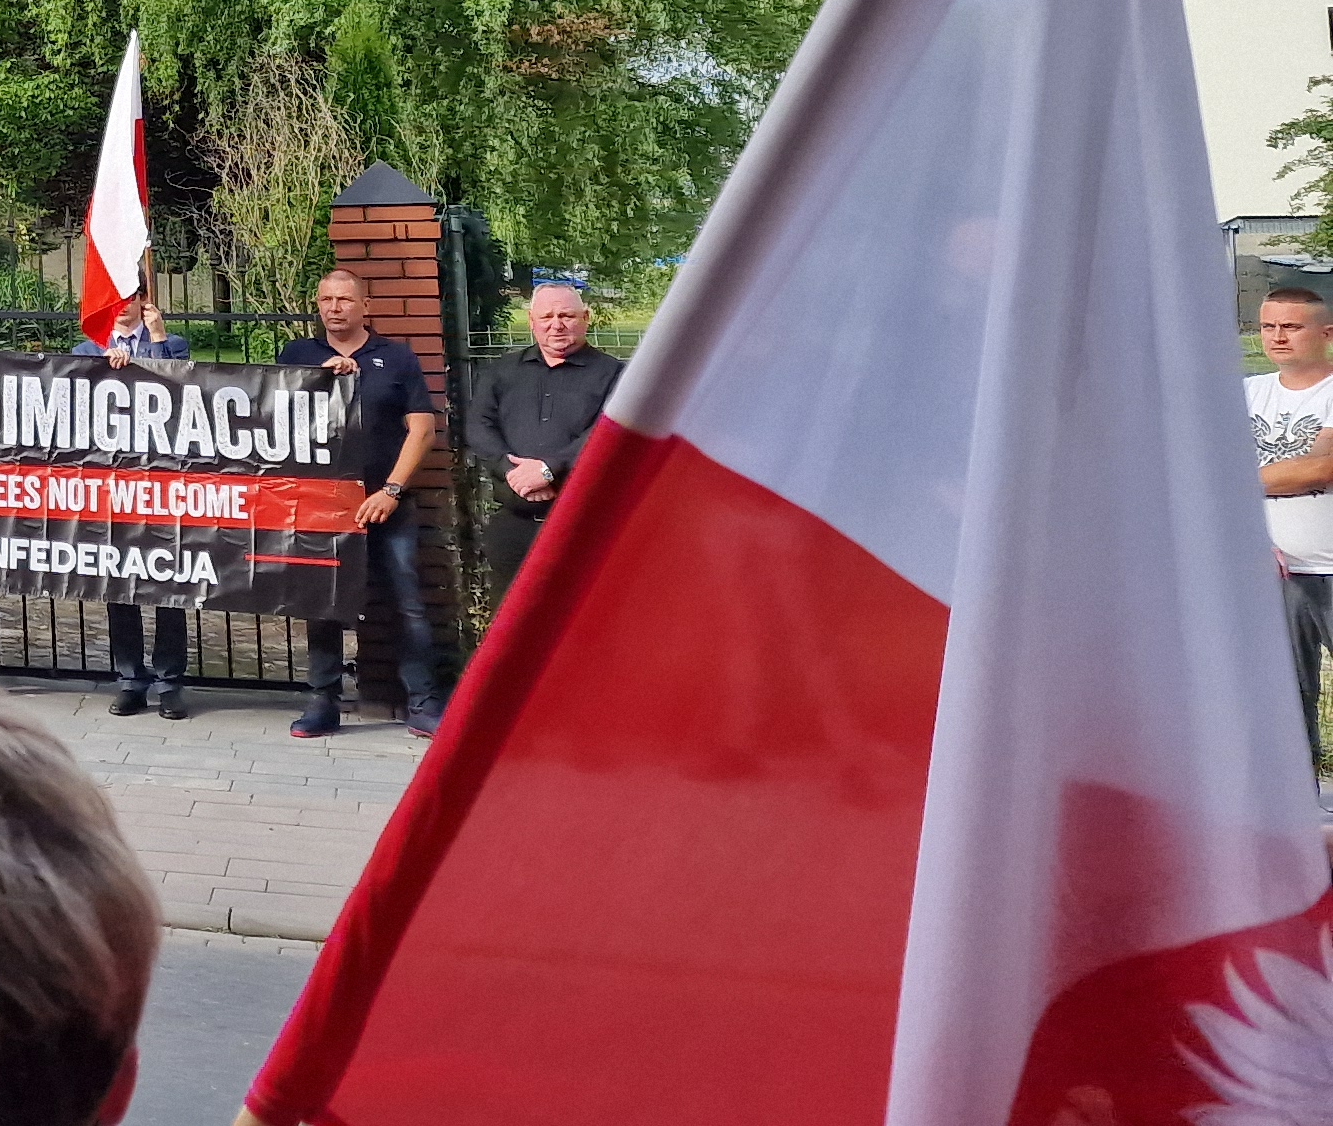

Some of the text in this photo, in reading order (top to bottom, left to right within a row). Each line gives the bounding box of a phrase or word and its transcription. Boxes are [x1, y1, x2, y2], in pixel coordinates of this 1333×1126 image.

[2, 374, 330, 464] IMIGRACJI!
[48, 476, 103, 513] NOT
[109, 479, 249, 519] WELCOME
